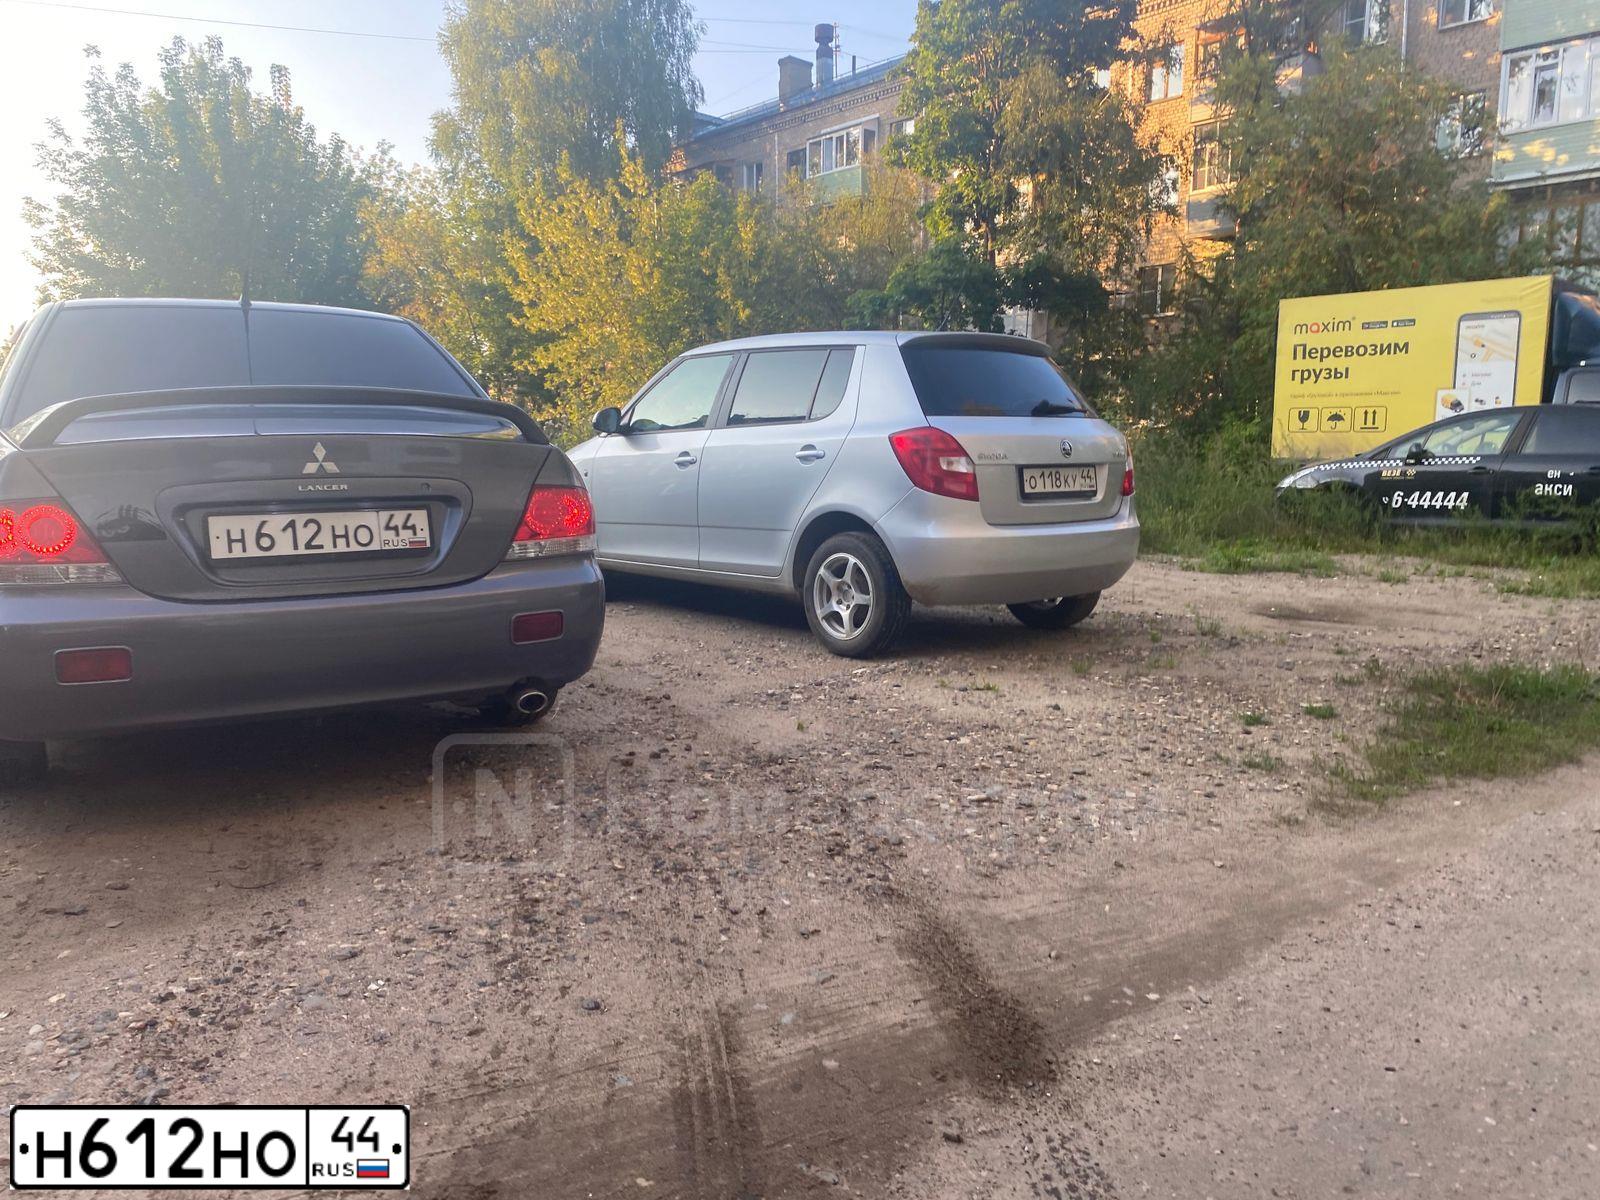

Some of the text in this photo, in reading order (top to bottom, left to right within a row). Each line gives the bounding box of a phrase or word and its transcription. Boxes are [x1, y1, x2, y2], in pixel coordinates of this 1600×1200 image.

[1294, 317, 1352, 335] maxim
[1293, 341, 1409, 362] Перевозим
[1291, 366, 1350, 384] грузы
[1080, 468, 1092, 483] 44
[297, 484, 348, 492] LANCER
[1392, 490, 1470, 510] 6-44444
[226, 513, 418, 554] Н612НО 44
[383, 538, 408, 548] RUS
